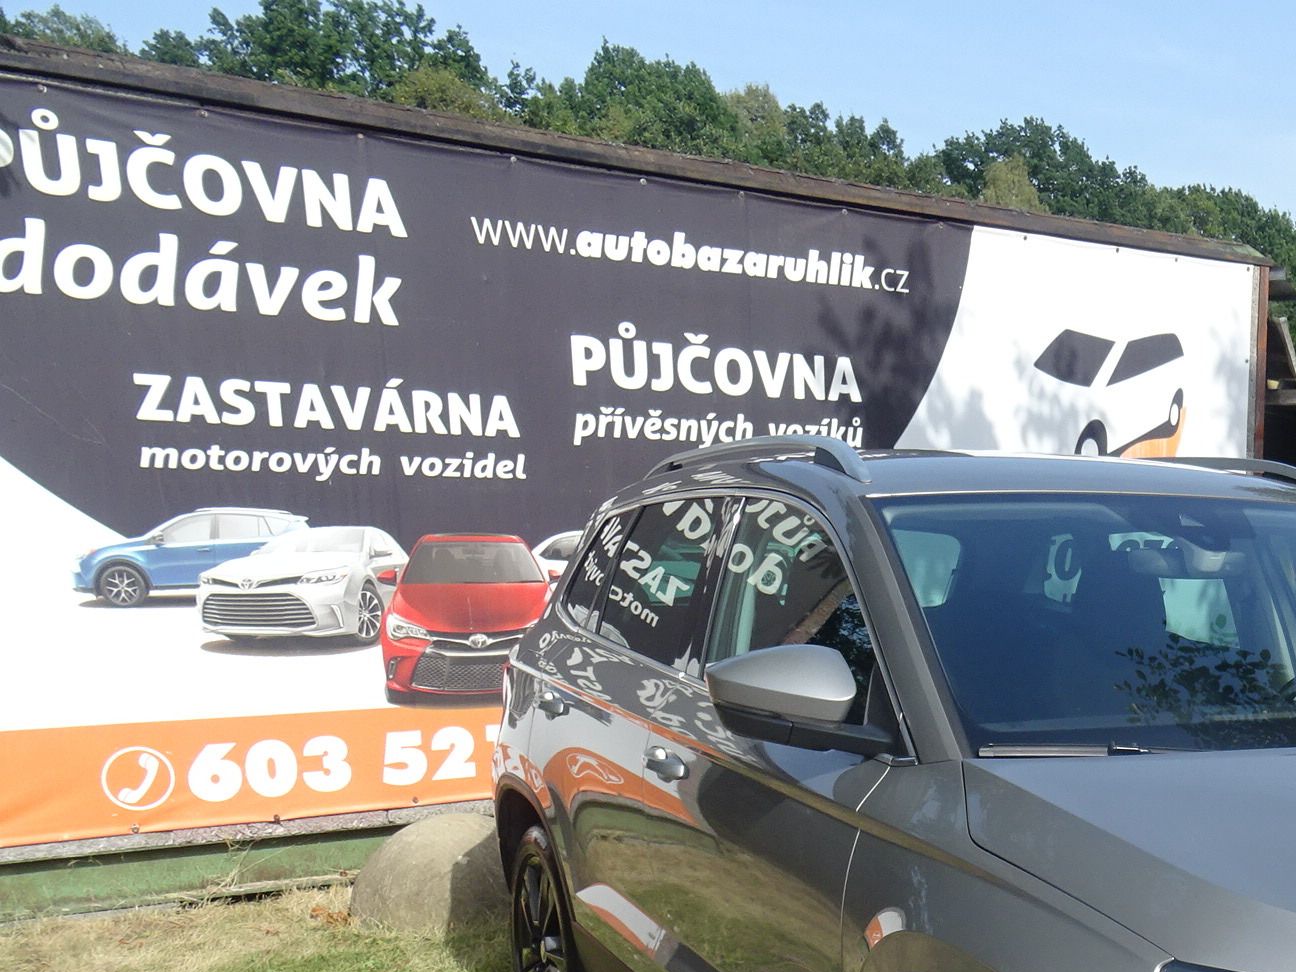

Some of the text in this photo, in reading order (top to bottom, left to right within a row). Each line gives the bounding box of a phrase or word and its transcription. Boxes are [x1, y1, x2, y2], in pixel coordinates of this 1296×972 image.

[0, 217, 402, 326] dodávek
[470, 216, 910, 293] www.autobazaruhlik.cz
[570, 321, 863, 403] PŮJČOVNA
[132, 373, 521, 438] ZASTAVÁRNA
[573, 406, 754, 448] přívěsných
[139, 444, 527, 481] motorových vozidel
[188, 735, 352, 802] 603
